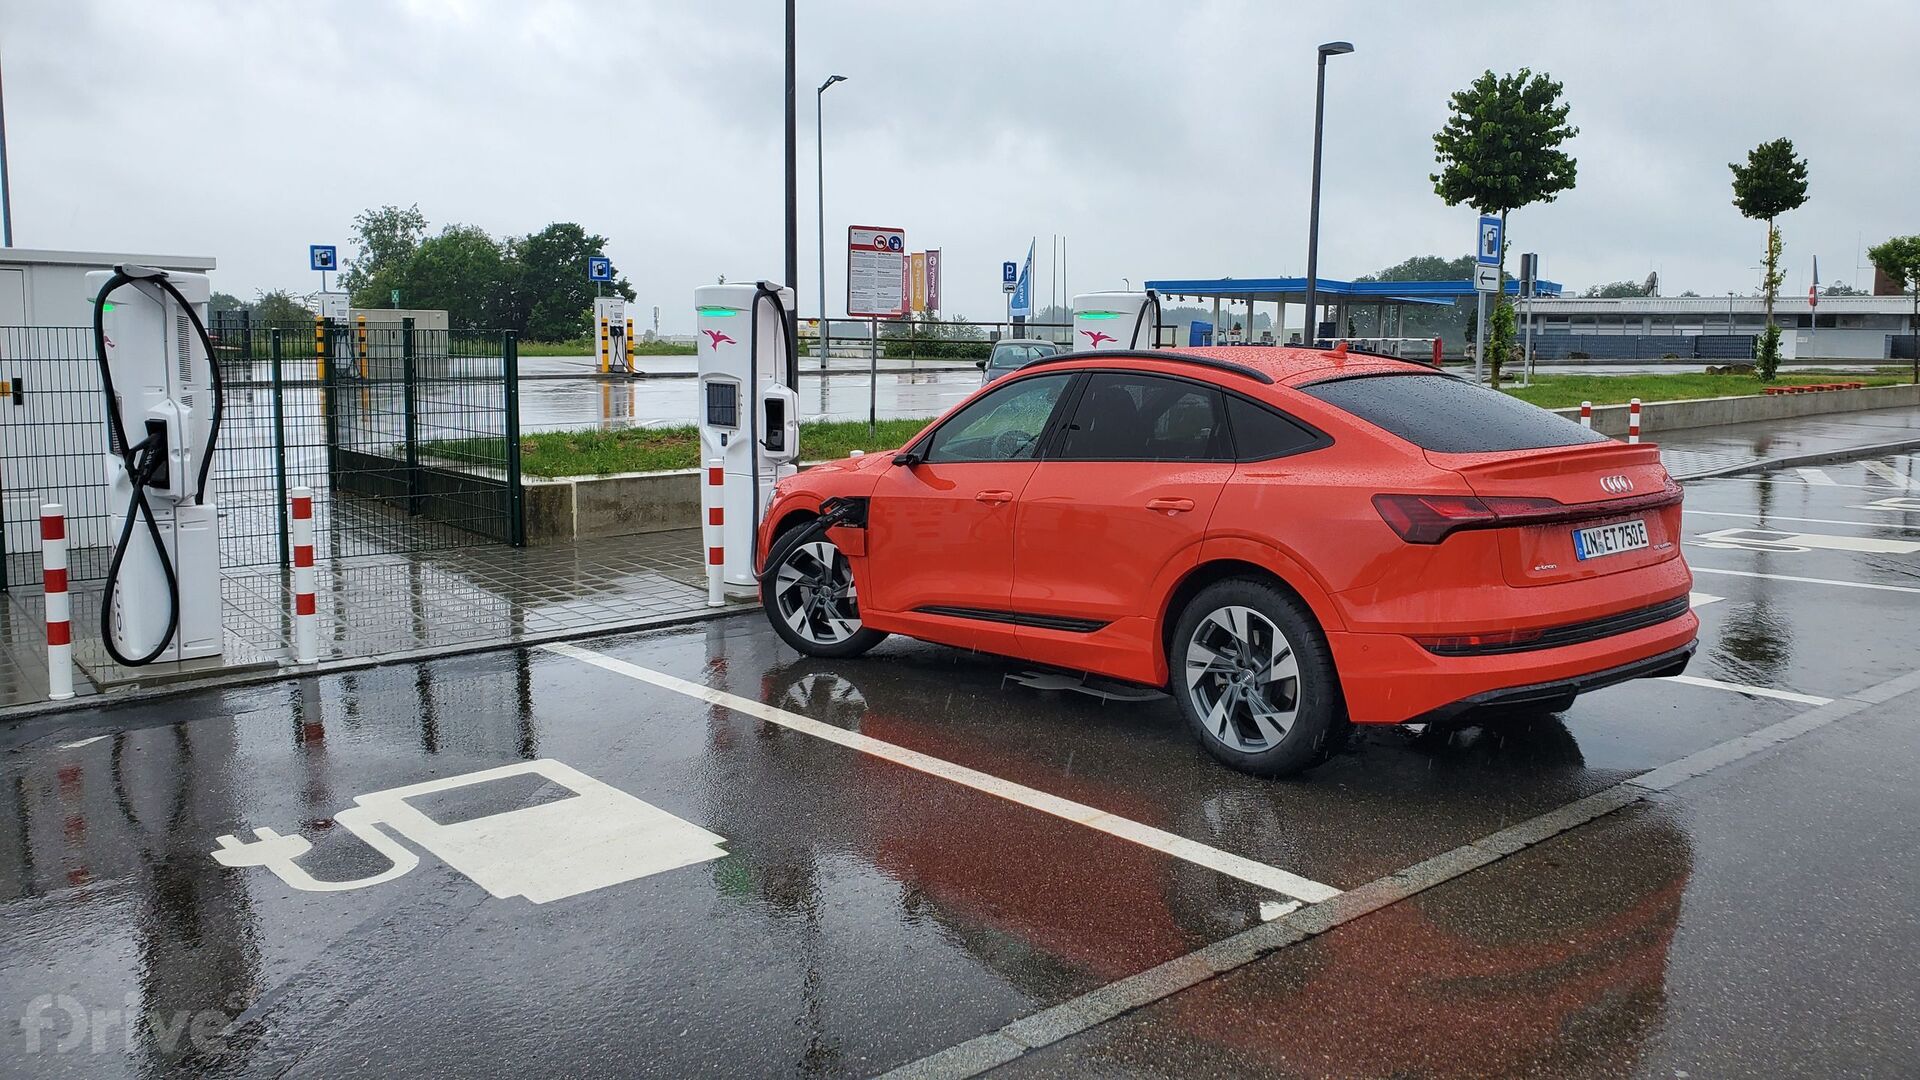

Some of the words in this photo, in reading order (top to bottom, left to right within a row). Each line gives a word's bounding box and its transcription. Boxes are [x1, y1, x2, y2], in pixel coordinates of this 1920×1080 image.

[1006, 264, 1014, 279] P
[1582, 531, 1599, 555] IN
[1603, 527, 1617, 551] ET
